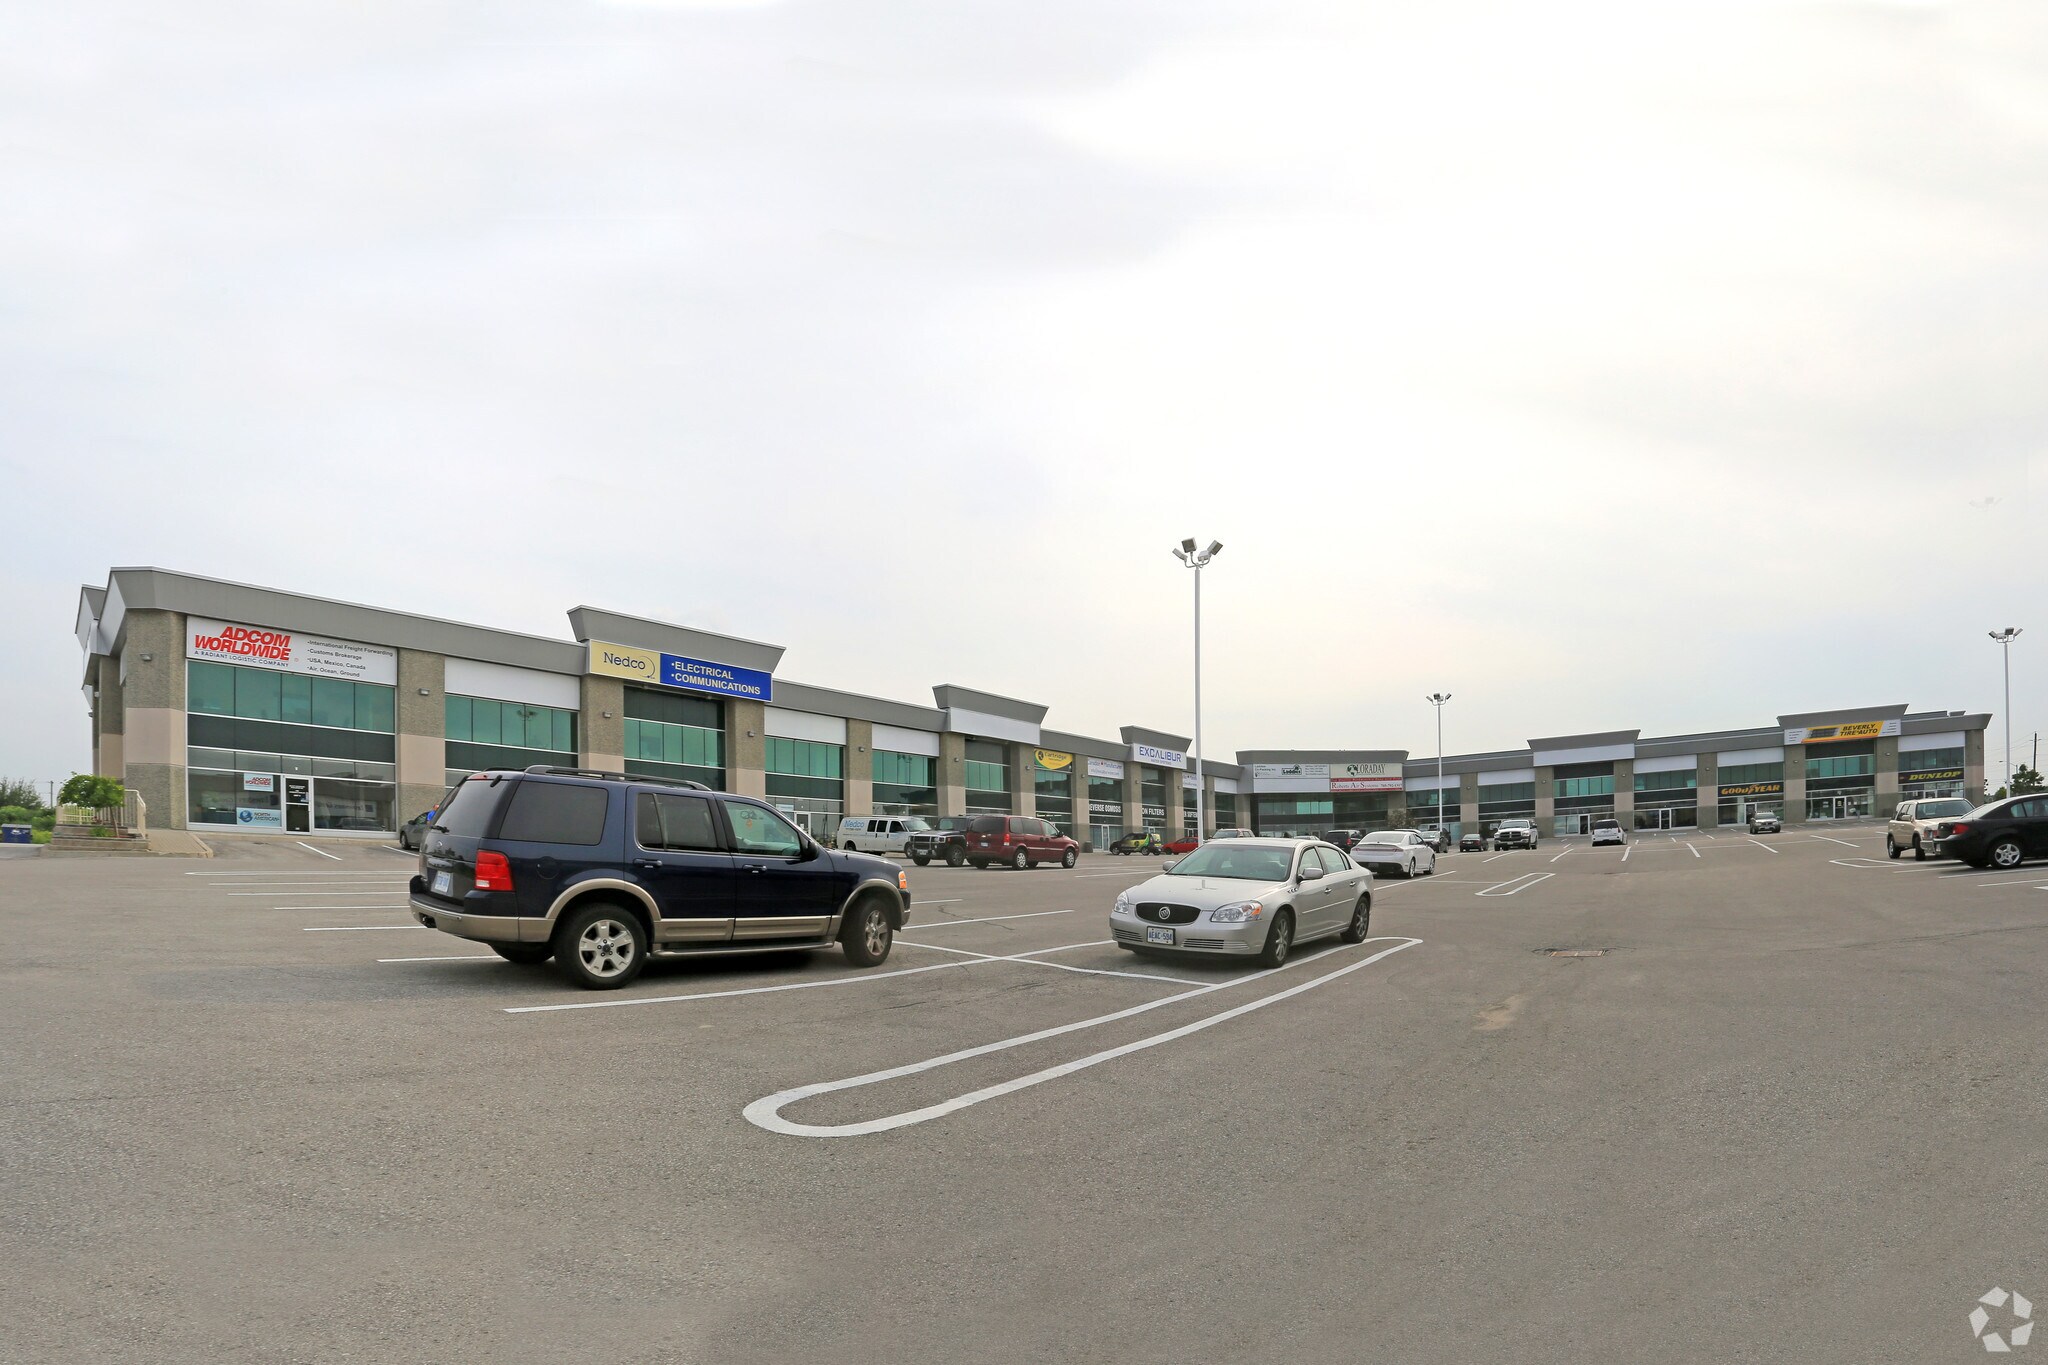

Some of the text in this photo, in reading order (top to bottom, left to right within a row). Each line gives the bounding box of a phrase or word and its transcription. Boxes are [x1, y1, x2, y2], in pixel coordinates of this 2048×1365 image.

[220, 626, 291, 647] ADCOM
[195, 634, 291, 661] WORLDWIDE
[364, 647, 393, 657] Forwarding
[201, 651, 228, 659] RADIANT
[229, 655, 257, 664] LOGISTIC
[258, 659, 289, 667] COMPANY
[334, 652, 362, 660] Brokerage
[603, 651, 646, 670] Nedco
[674, 661, 734, 680] ELECTRICAL
[675, 672, 761, 695] COMMUNICATIONS
[1843, 723, 1876, 731] BEVERLY
[1139, 746, 1182, 762] EXCALIBUR
[1909, 771, 1962, 780] DUNLOP
[1721, 784, 1780, 795] GOODYEAR
[1148, 808, 1165, 816] FILTERS
